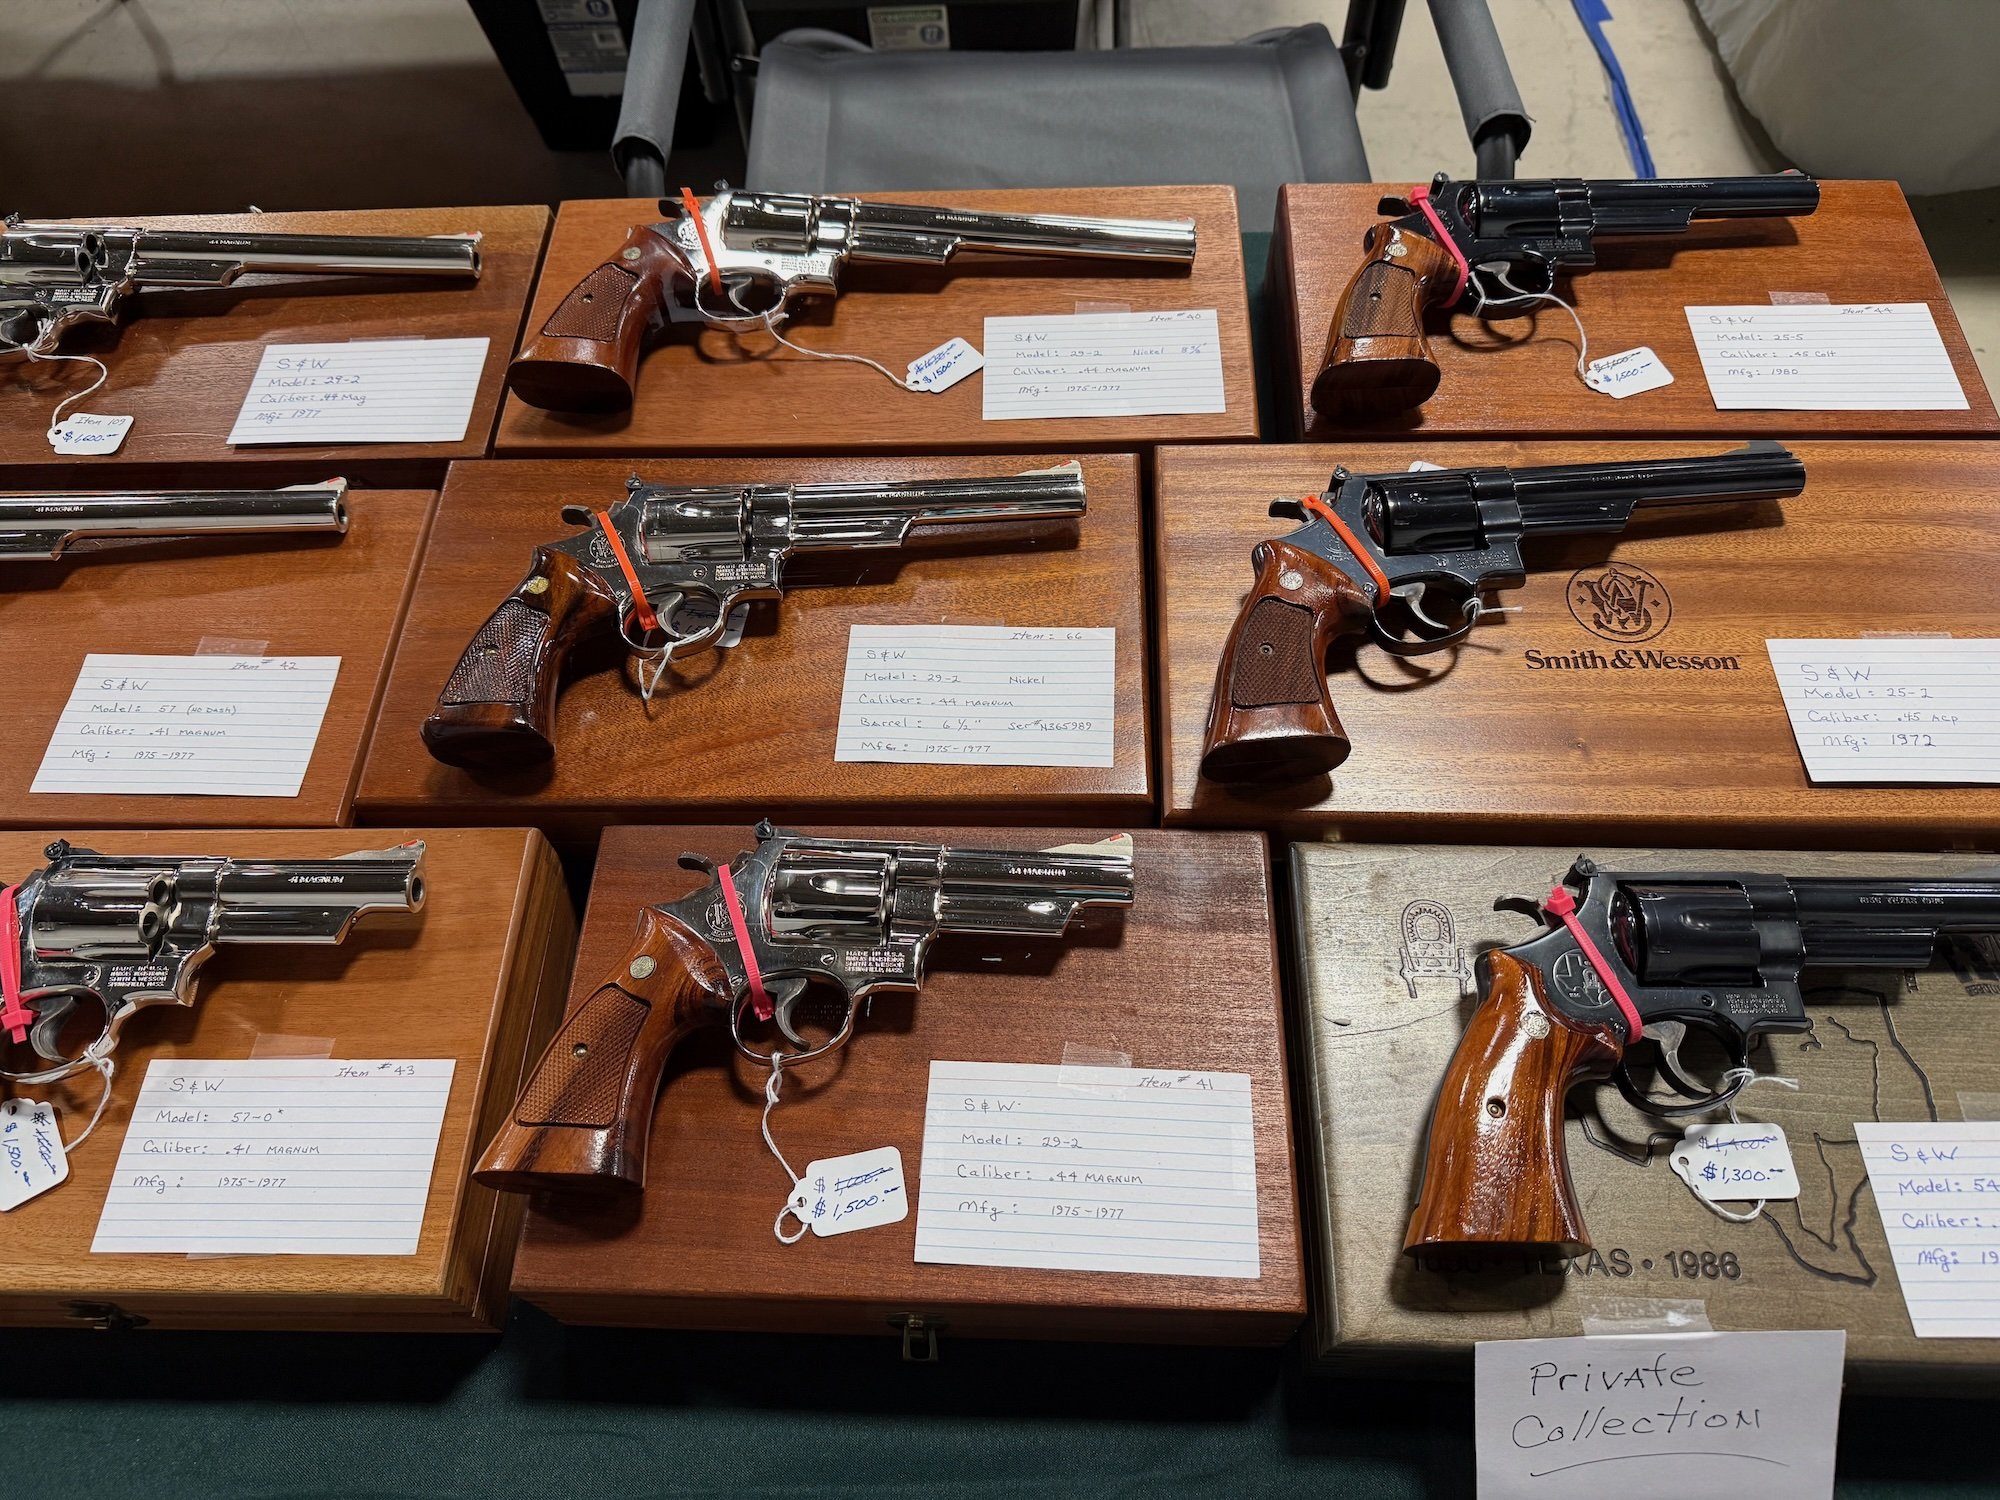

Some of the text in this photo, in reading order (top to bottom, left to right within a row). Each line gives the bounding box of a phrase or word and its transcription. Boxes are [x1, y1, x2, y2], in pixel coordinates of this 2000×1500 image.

[1716, 333, 1763, 341] Model:
[1132, 347, 1164, 356] Nickel
[1720, 350, 1837, 359] Caliber: .45 Colt
[1771, 368, 1799, 376] 1980
[323, 375, 361, 385] 29-2
[292, 409, 322, 419] 1977
[75, 416, 102, 425] Item
[1066, 631, 1083, 641] 66
[229, 660, 260, 671] Item
[926, 673, 961, 683] 29-2
[1008, 674, 1046, 685] Nickel
[1886, 686, 1935, 699] 25-2
[858, 693, 1015, 708] Caliber: .44 MAGNUM
[90, 703, 142, 714] Model:
[157, 704, 177, 713] 57
[1807, 709, 1879, 724] Caliber:
[1897, 711, 1922, 722] .45
[80, 724, 135, 736] Caliber:
[148, 726, 170, 736] .41
[1891, 733, 1937, 748] 1972
[924, 743, 992, 753] 1975-1977
[133, 750, 196, 760] 1975-1977
[1022, 868, 1067, 877] MAGNUM
[299, 875, 345, 884] MAGNUM
[334, 1066, 369, 1078] Item
[1136, 1076, 1173, 1090] Item
[155, 1110, 208, 1124] Model:
[142, 1138, 321, 1156] Caliber: .41 MAGNUM
[961, 1132, 1084, 1150] Model: 29-2
[956, 1163, 1144, 1185] Caliber: .44 MAGNUM
[217, 1176, 288, 1189] 1975-1977
[1898, 1177, 1963, 1196] Model:
[1051, 1205, 1124, 1220] 1975-1977
[1901, 1211, 1983, 1230] Caliber:
[1663, 1250, 1743, 1281] 1986
